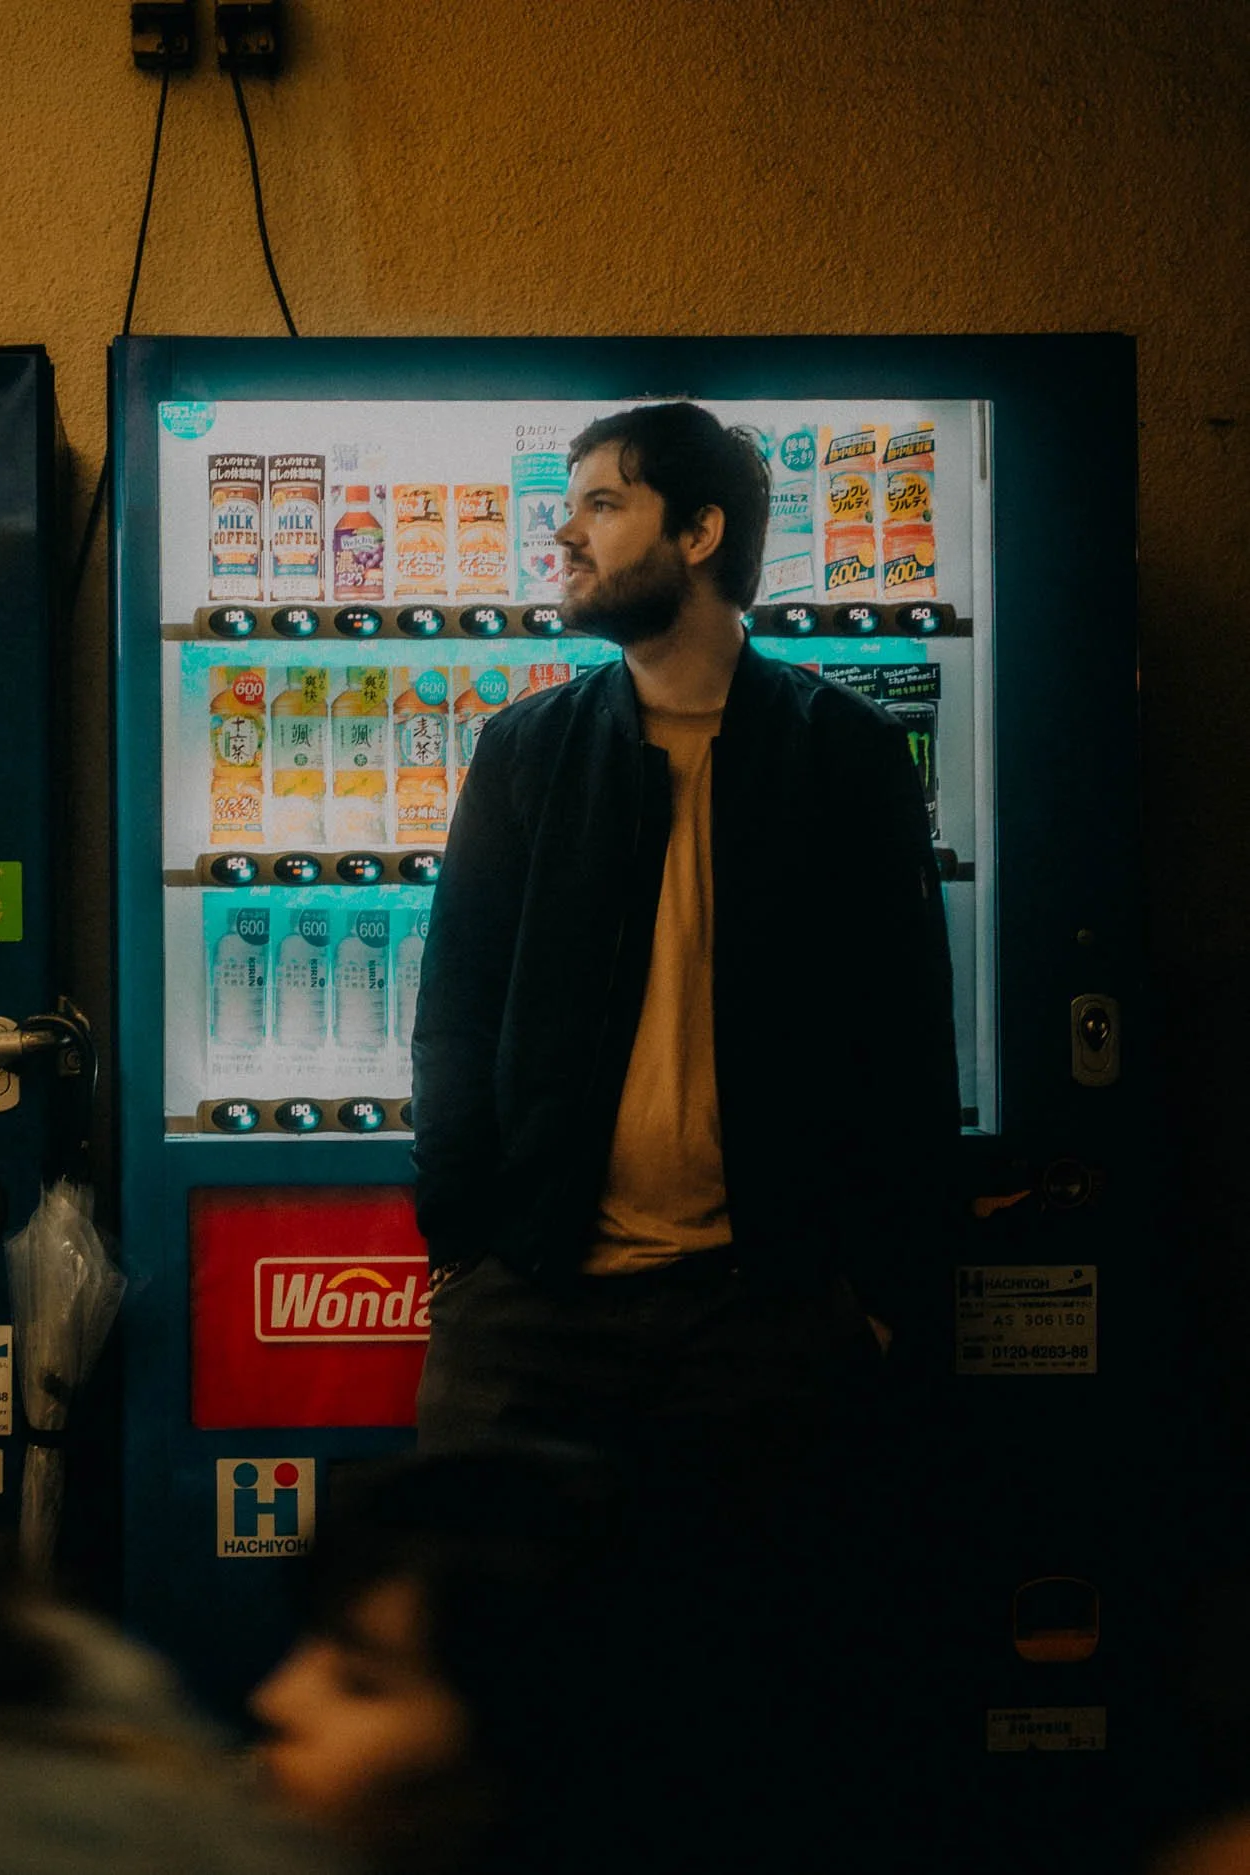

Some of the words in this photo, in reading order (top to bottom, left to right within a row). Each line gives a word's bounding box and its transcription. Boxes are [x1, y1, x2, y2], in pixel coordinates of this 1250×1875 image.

[218, 514, 254, 530] MILK
[278, 514, 314, 530] MILK
[214, 531, 258, 545] COFFEE
[274, 531, 318, 545] COFFEE
[225, 611, 245, 623] 130
[288, 611, 308, 623] 130
[413, 610, 433, 622] 150
[475, 610, 495, 622] 150
[533, 610, 557, 621] 200
[786, 609, 807, 621] 150
[849, 608, 870, 620] 150
[911, 608, 931, 619] 150
[235, 682, 263, 696] 600
[419, 682, 446, 695] 600
[479, 682, 506, 695] 600
[231, 716, 248, 763] 十六茶
[291, 723, 312, 748] 颯
[351, 723, 372, 748] 颯
[414, 716, 434, 762] 麦茶
[227, 857, 247, 870] 150
[415, 857, 434, 869] 140
[239, 920, 265, 936] 600
[302, 921, 327, 936] 600
[359, 922, 385, 937] 600
[248, 956, 257, 987] KIRIN
[310, 958, 318, 988] KIRIN
[368, 959, 377, 989] KIRIN
[227, 1104, 248, 1117] 130
[291, 1104, 311, 1116] 130
[353, 1103, 374, 1116] 130
[985, 1278, 1050, 1290] HACHIYOH
[993, 1314, 1015, 1326] AS
[1025, 1313, 1086, 1326] 306150
[992, 1346, 1088, 1359] 0120-8263-88
[224, 1540, 309, 1554] HACHIYOH
